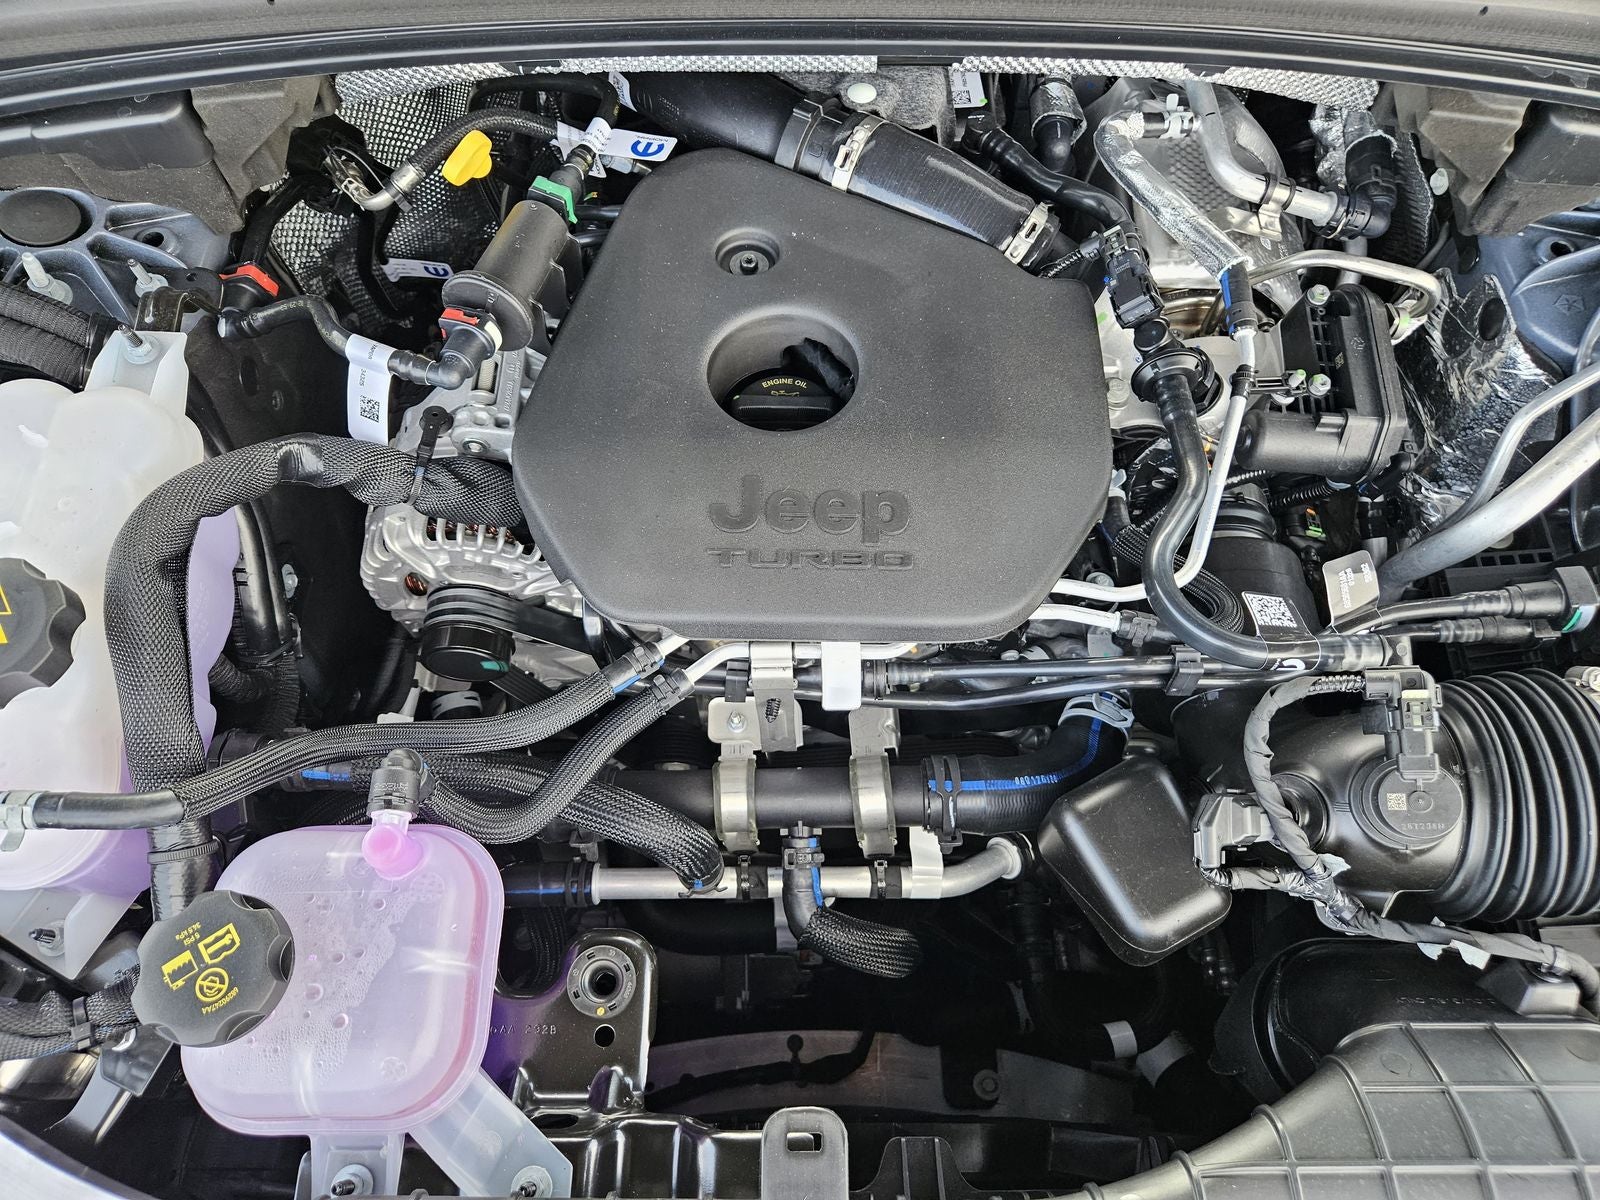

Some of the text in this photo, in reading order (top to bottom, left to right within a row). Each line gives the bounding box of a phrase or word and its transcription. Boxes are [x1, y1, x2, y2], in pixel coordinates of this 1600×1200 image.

[761, 378, 807, 389] ENGINE OIL
[708, 474, 911, 547] Jeep
[706, 549, 914, 571] TURBO
